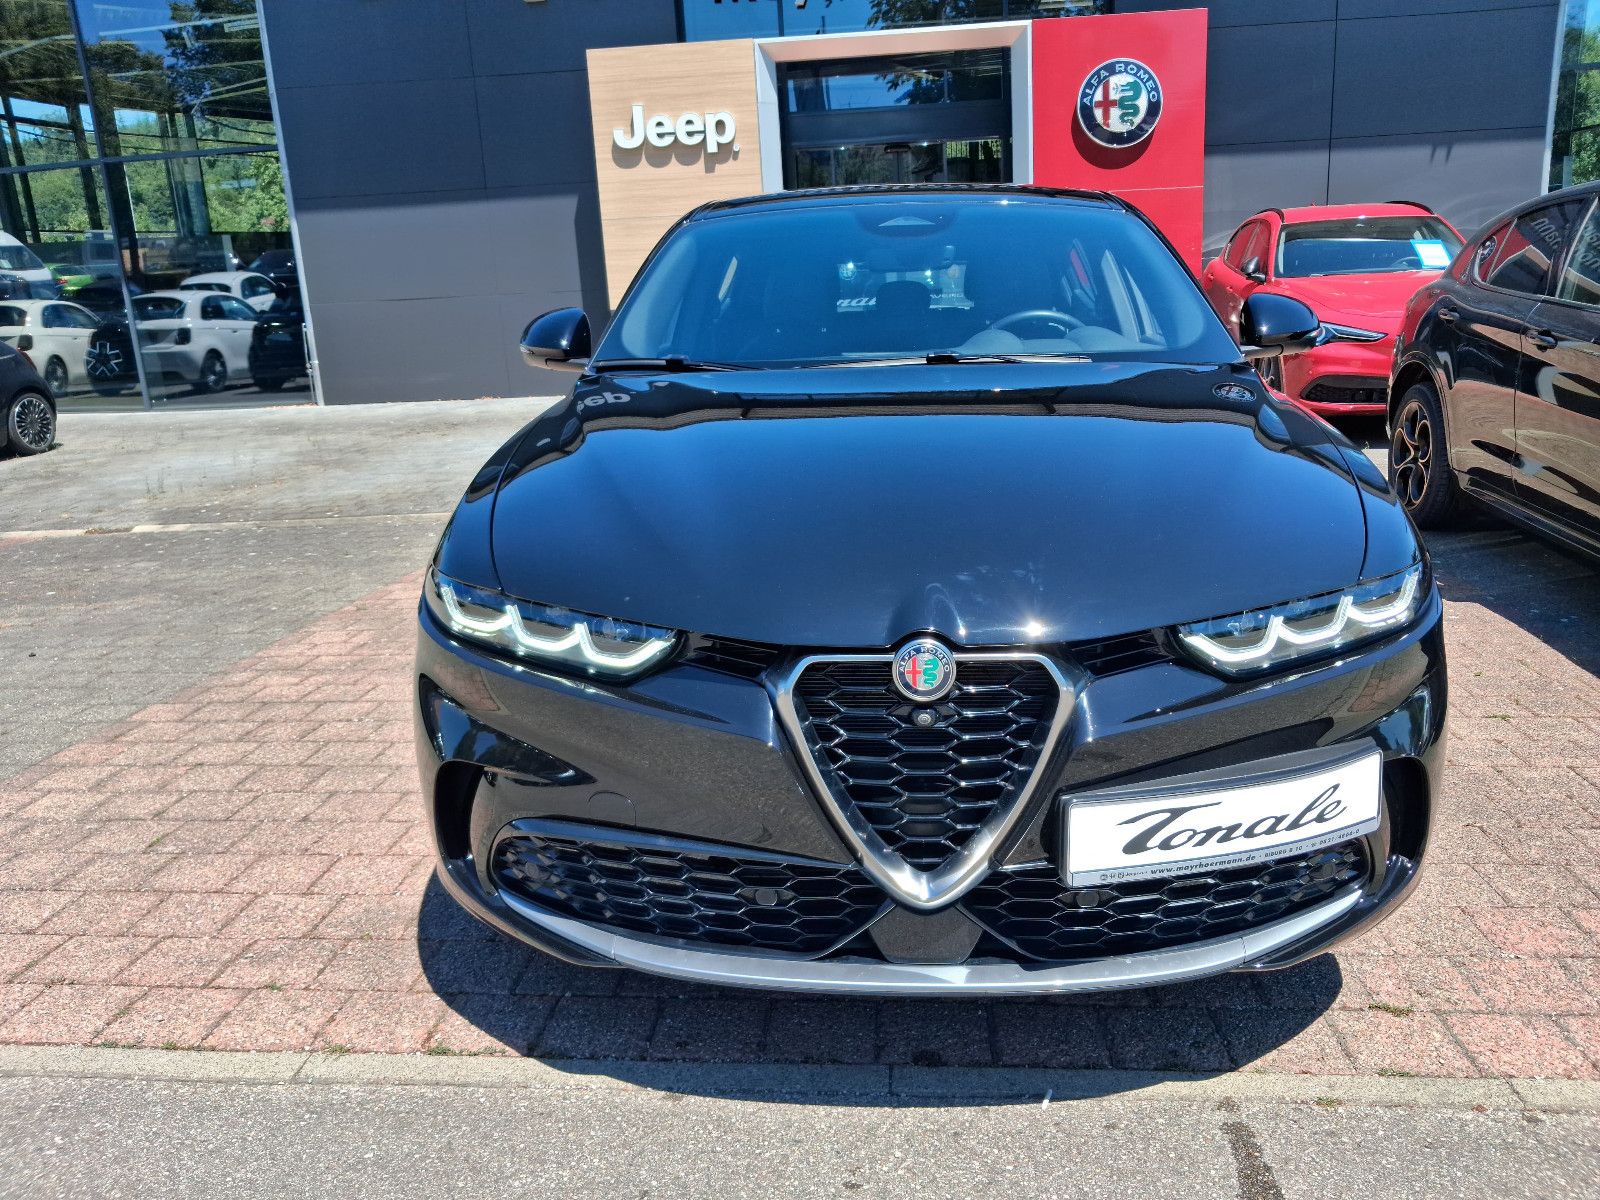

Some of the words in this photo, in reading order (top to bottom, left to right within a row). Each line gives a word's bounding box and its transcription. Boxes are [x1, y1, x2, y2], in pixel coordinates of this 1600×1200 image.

[1083, 69, 1109, 106] ALFA
[1115, 63, 1158, 102] ROMEO
[613, 104, 737, 153] Jeep
[899, 650, 917, 673] ALFA
[920, 646, 950, 672] ROMEO
[1117, 783, 1347, 855] Tonale
